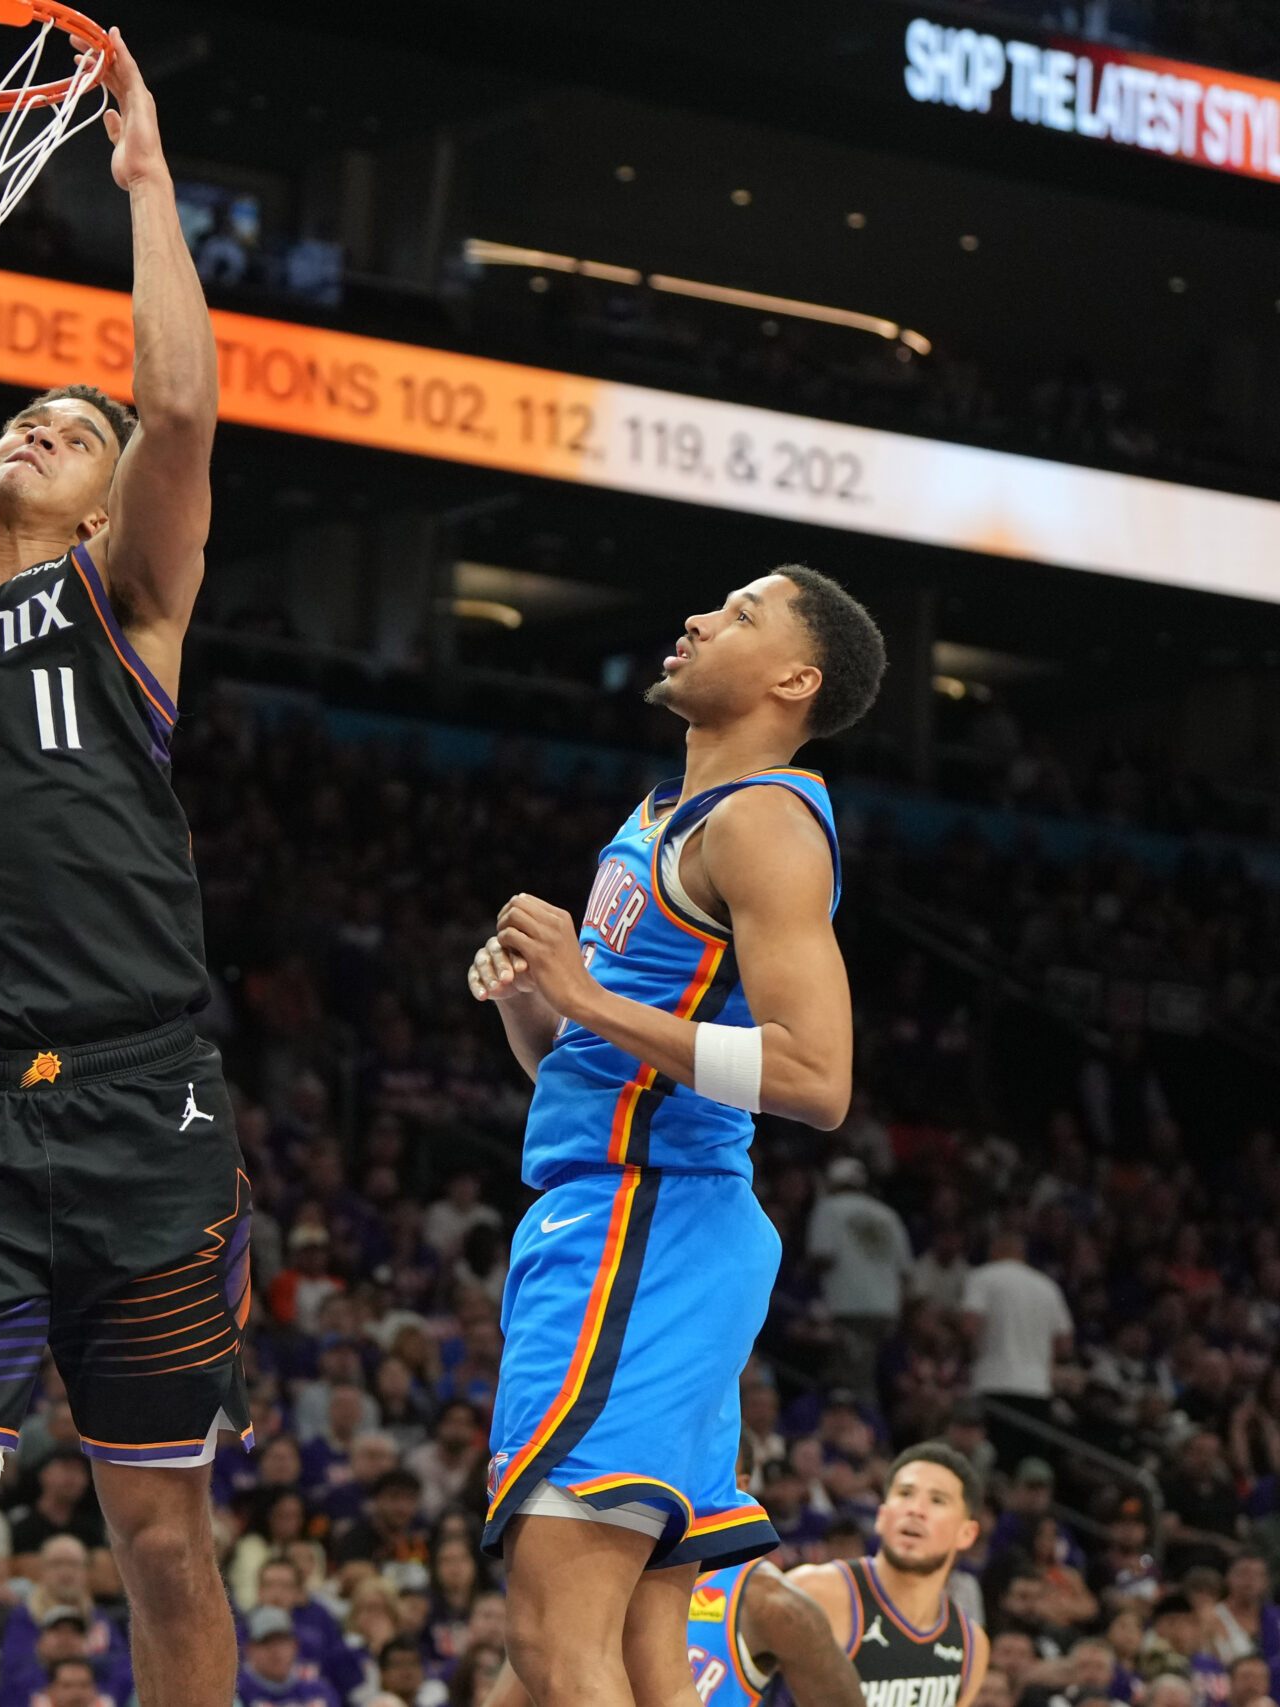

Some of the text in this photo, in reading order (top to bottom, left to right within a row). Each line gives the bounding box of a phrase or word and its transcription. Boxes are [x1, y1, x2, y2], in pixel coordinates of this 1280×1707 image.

[904, 18, 1280, 178] SHOP THE LATEST STYL
[96, 317, 379, 415] STIONS
[726, 432, 761, 481] &
[31, 666, 82, 750] 11
